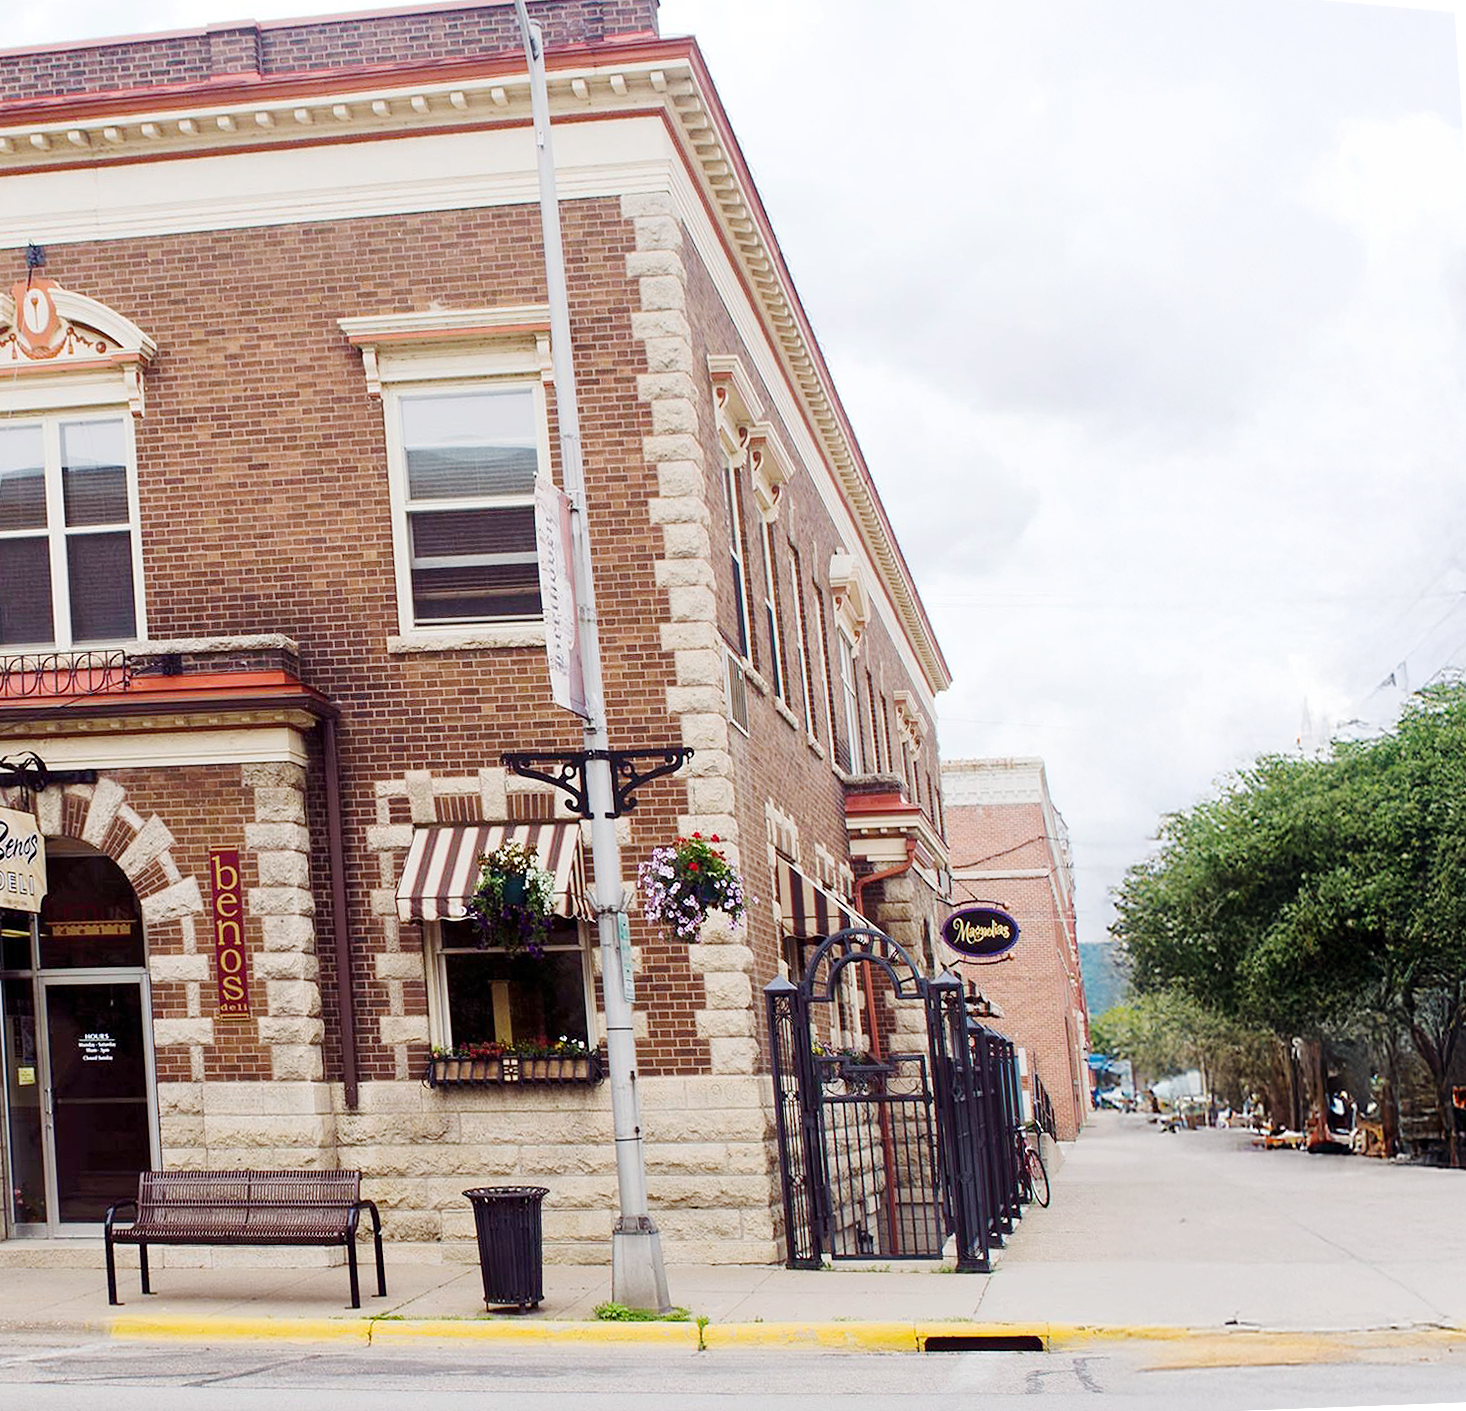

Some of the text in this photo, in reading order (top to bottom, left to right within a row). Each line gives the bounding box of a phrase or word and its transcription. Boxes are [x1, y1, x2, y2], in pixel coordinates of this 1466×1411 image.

[211, 854, 246, 1001] benos
[952, 917, 1011, 944] Magnolias
[220, 1003, 249, 1011] deli
